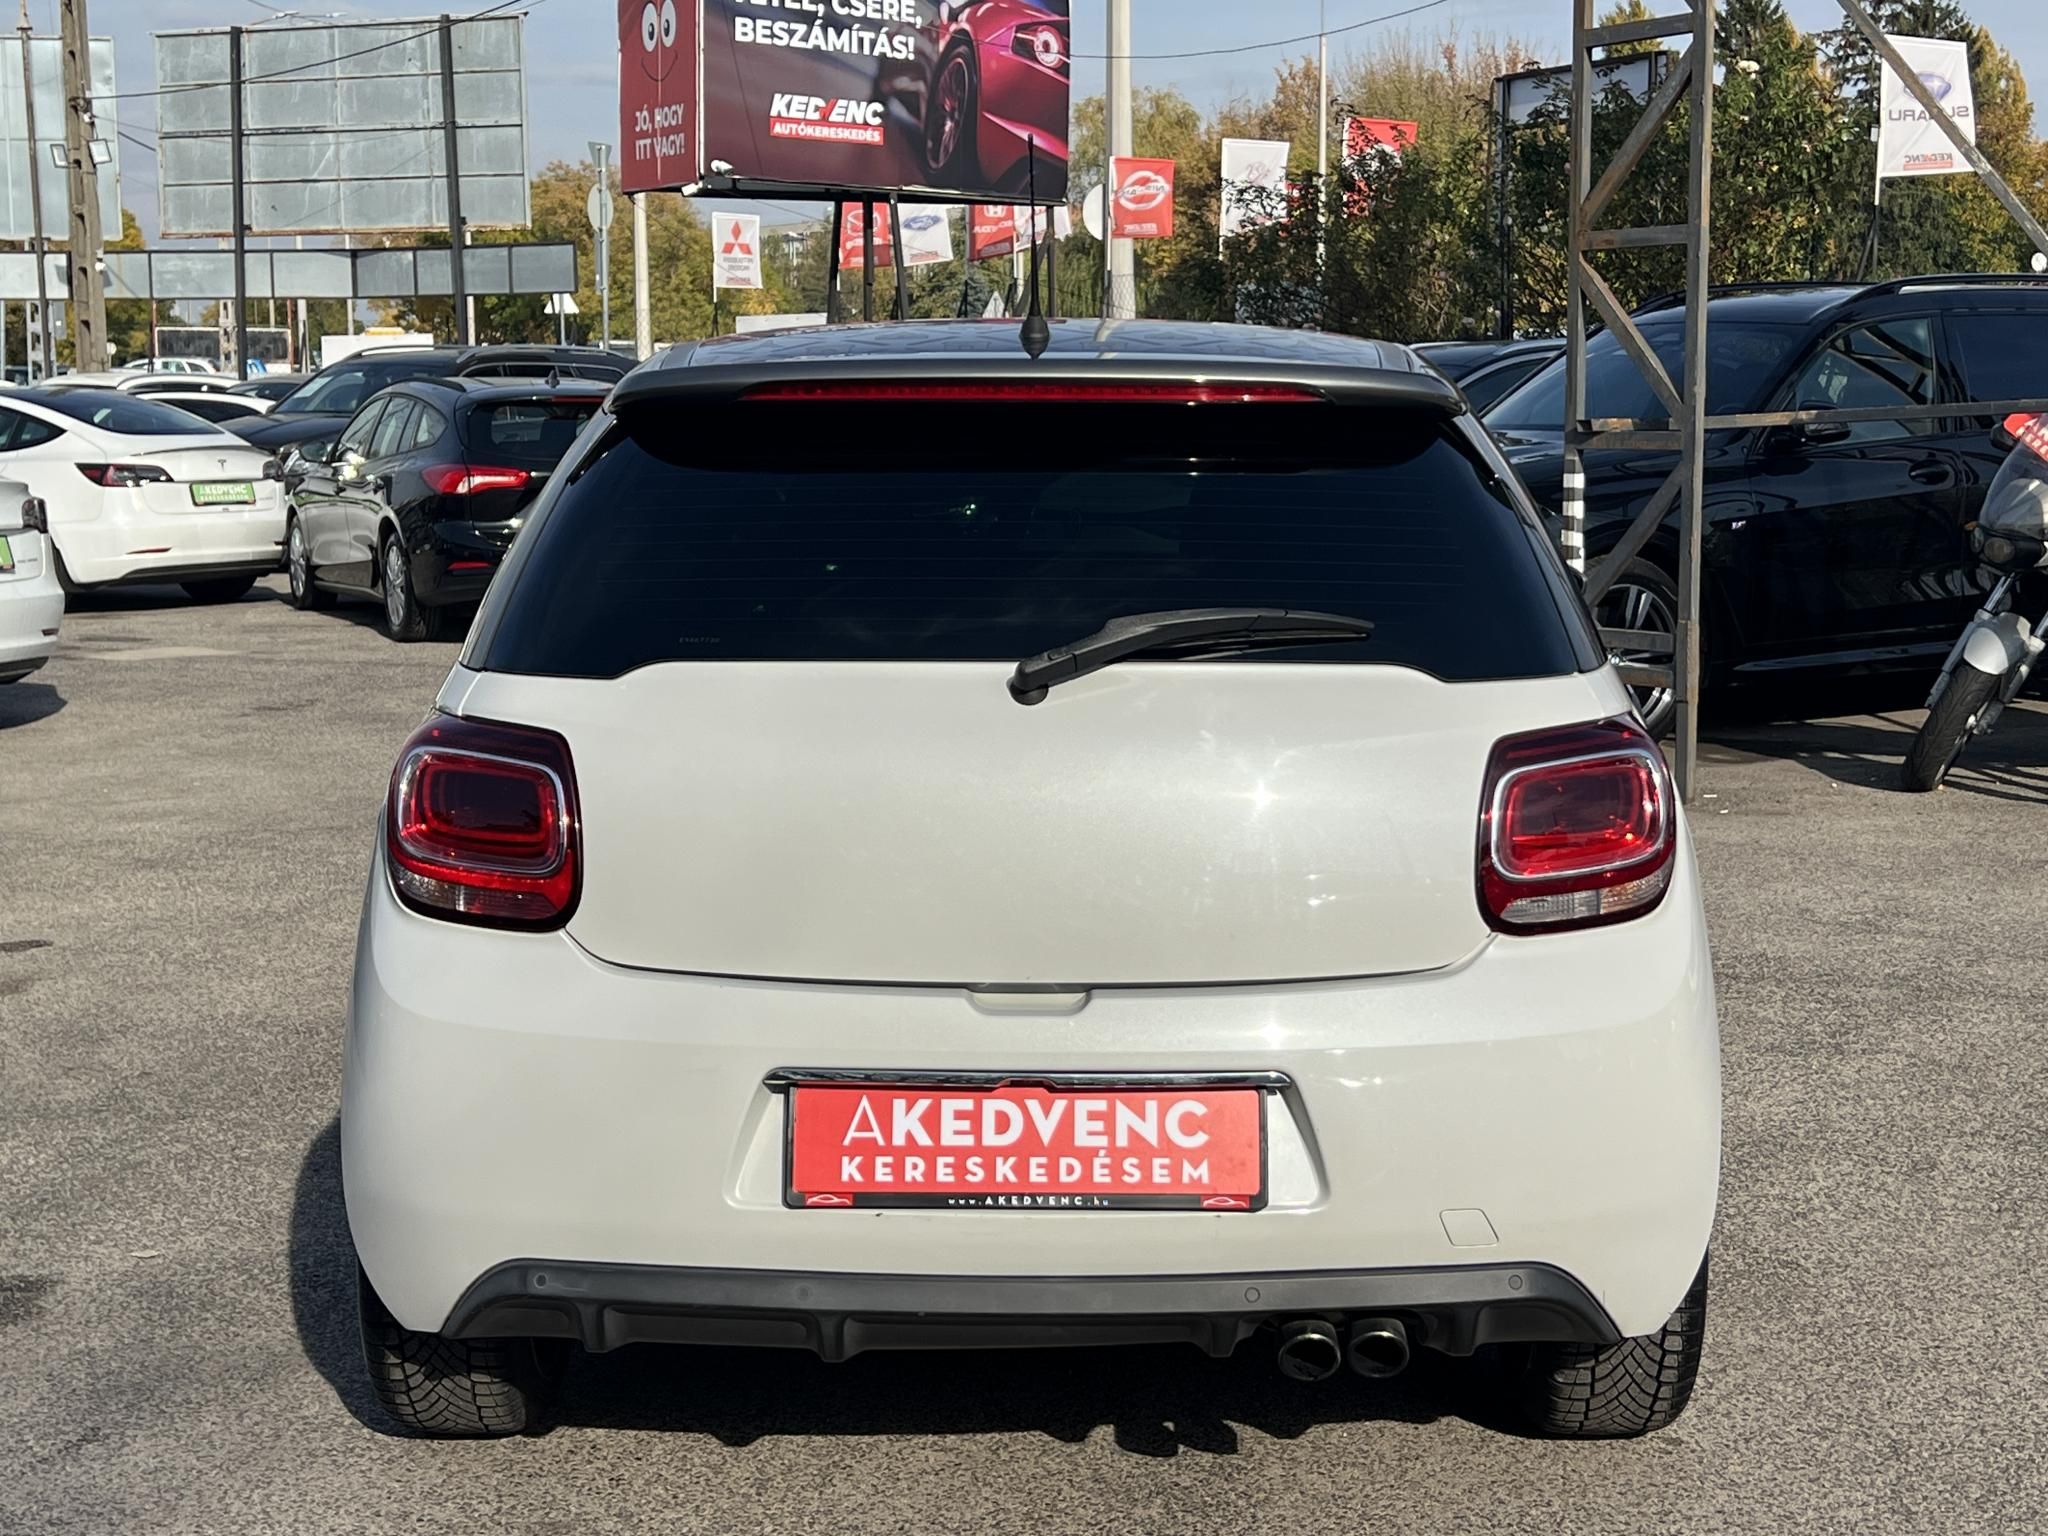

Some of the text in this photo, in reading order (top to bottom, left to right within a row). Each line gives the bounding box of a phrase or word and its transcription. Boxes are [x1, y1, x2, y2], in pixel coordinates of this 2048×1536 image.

[831, 0, 923, 29] CSERE,
[734, 16, 915, 60] BESZÁMÍTÁS!
[635, 103, 684, 134] JÓ, HOGY
[773, 121, 880, 143] AUTÓKERESKEDÉS
[635, 132, 685, 160] ITT VAGY!
[840, 1150, 1210, 1185] KERESKEDÉSEM
[948, 1195, 1109, 1206] www.AKEDVENC.hu
